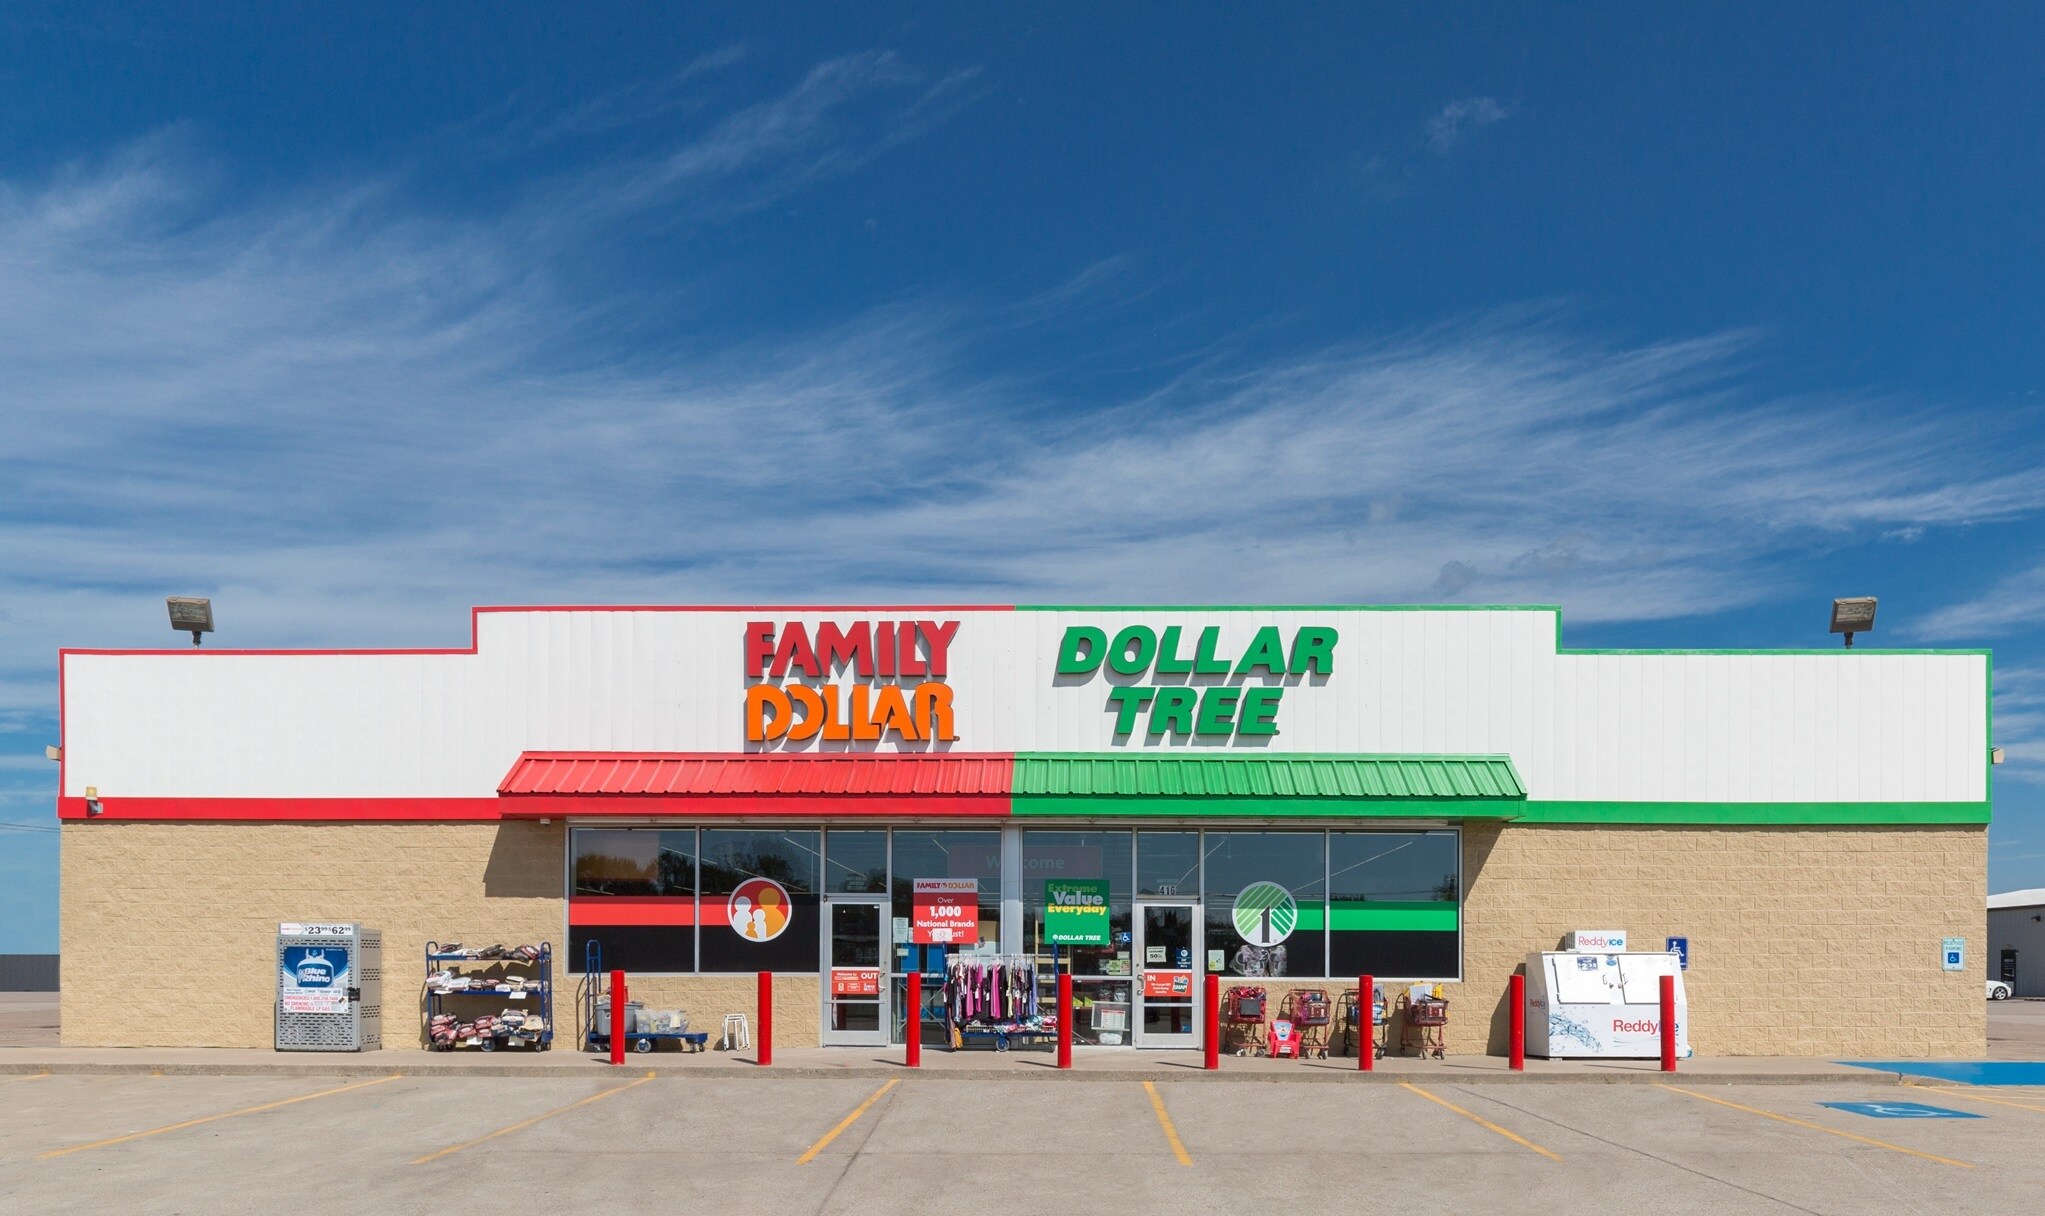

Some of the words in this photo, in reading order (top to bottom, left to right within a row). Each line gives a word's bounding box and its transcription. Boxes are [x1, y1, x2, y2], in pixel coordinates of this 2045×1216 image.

[747, 621, 960, 678] FAMILY
[1058, 625, 1338, 675] DOLLAR
[747, 682, 955, 741] DOLLAR
[1110, 687, 1284, 735] TREE
[1048, 884, 1098, 893] Extreme
[1160, 886, 1175, 895] 416
[1053, 890, 1103, 905] Value
[930, 906, 962, 919] 1,000
[1048, 903, 1107, 915] Everyday
[917, 920, 948, 928] National
[950, 920, 975, 928] Brands
